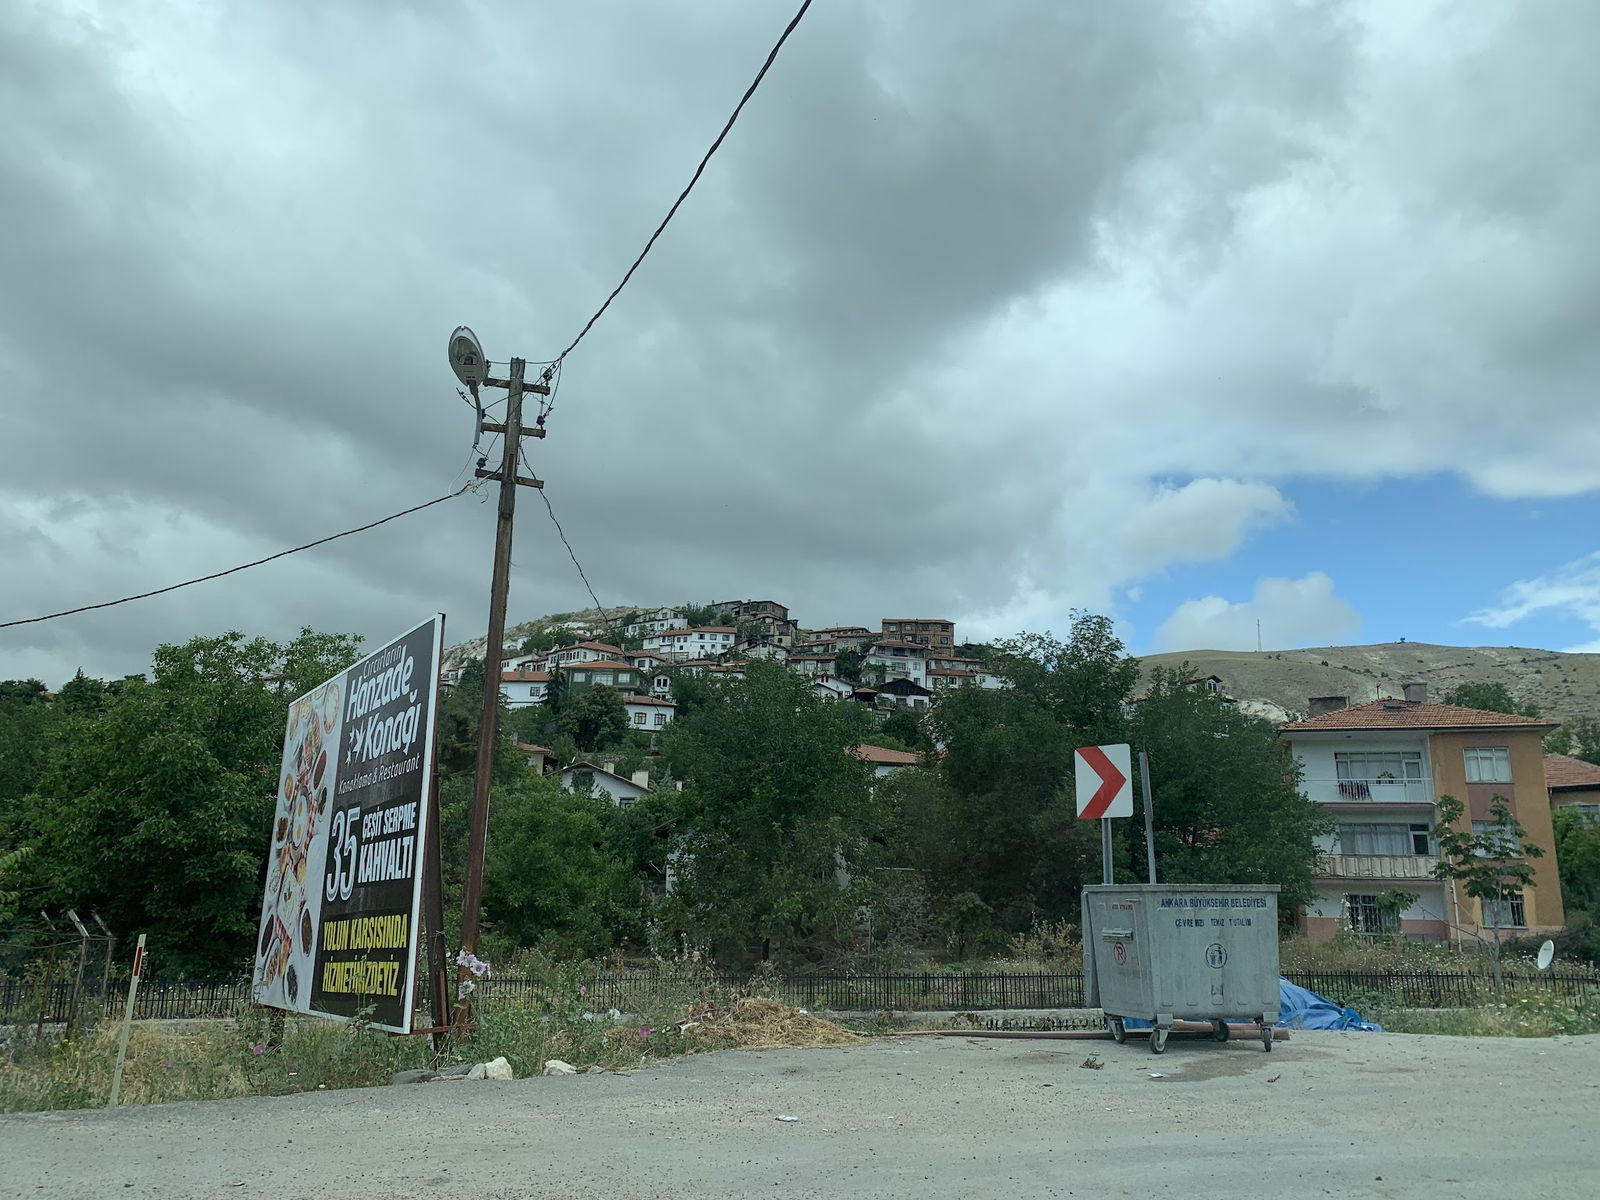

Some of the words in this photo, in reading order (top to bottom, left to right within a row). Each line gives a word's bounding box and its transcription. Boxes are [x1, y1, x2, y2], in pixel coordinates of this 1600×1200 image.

[346, 644, 414, 723] Hanzade
[362, 688, 421, 763] Konağı
[372, 767, 378, 784] &
[379, 752, 420, 783] Restaurant
[362, 806, 383, 842] ÇEŞİT
[383, 801, 417, 834] SERPME
[326, 806, 361, 902] 35
[358, 835, 415, 884] KAHVALTI
[1160, 897, 1188, 908] ANKARA
[323, 919, 349, 951] YOLUN
[350, 913, 408, 953] KARŞISINDA
